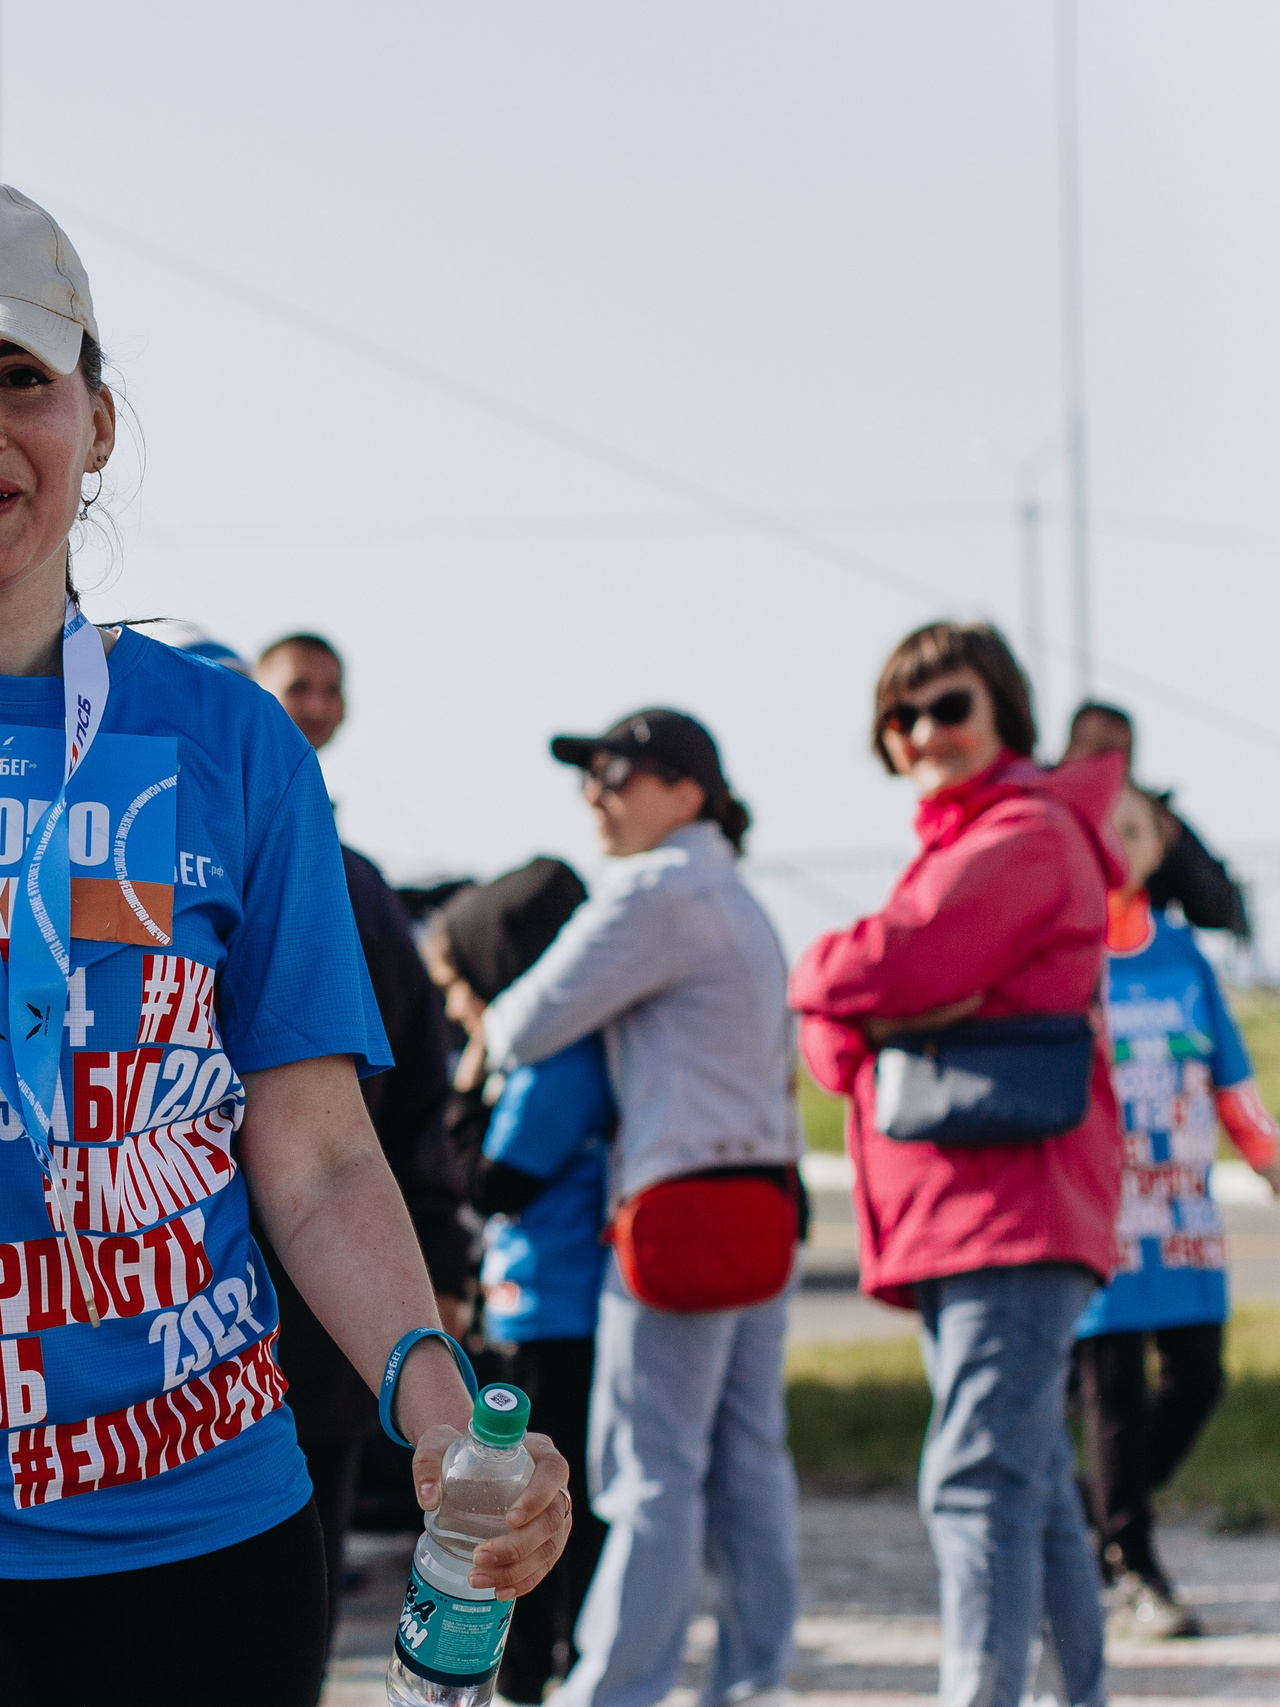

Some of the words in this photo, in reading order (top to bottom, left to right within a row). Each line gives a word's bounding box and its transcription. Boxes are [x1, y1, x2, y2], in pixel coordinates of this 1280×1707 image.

[75, 694, 91, 748] ПСБ
[33, 802, 64, 862] #УДИВЛЕНИЕ
[27, 863, 40, 896] #ТРЕПЕТ
[29, 894, 59, 943] #ВОЛНЕНИЕ
